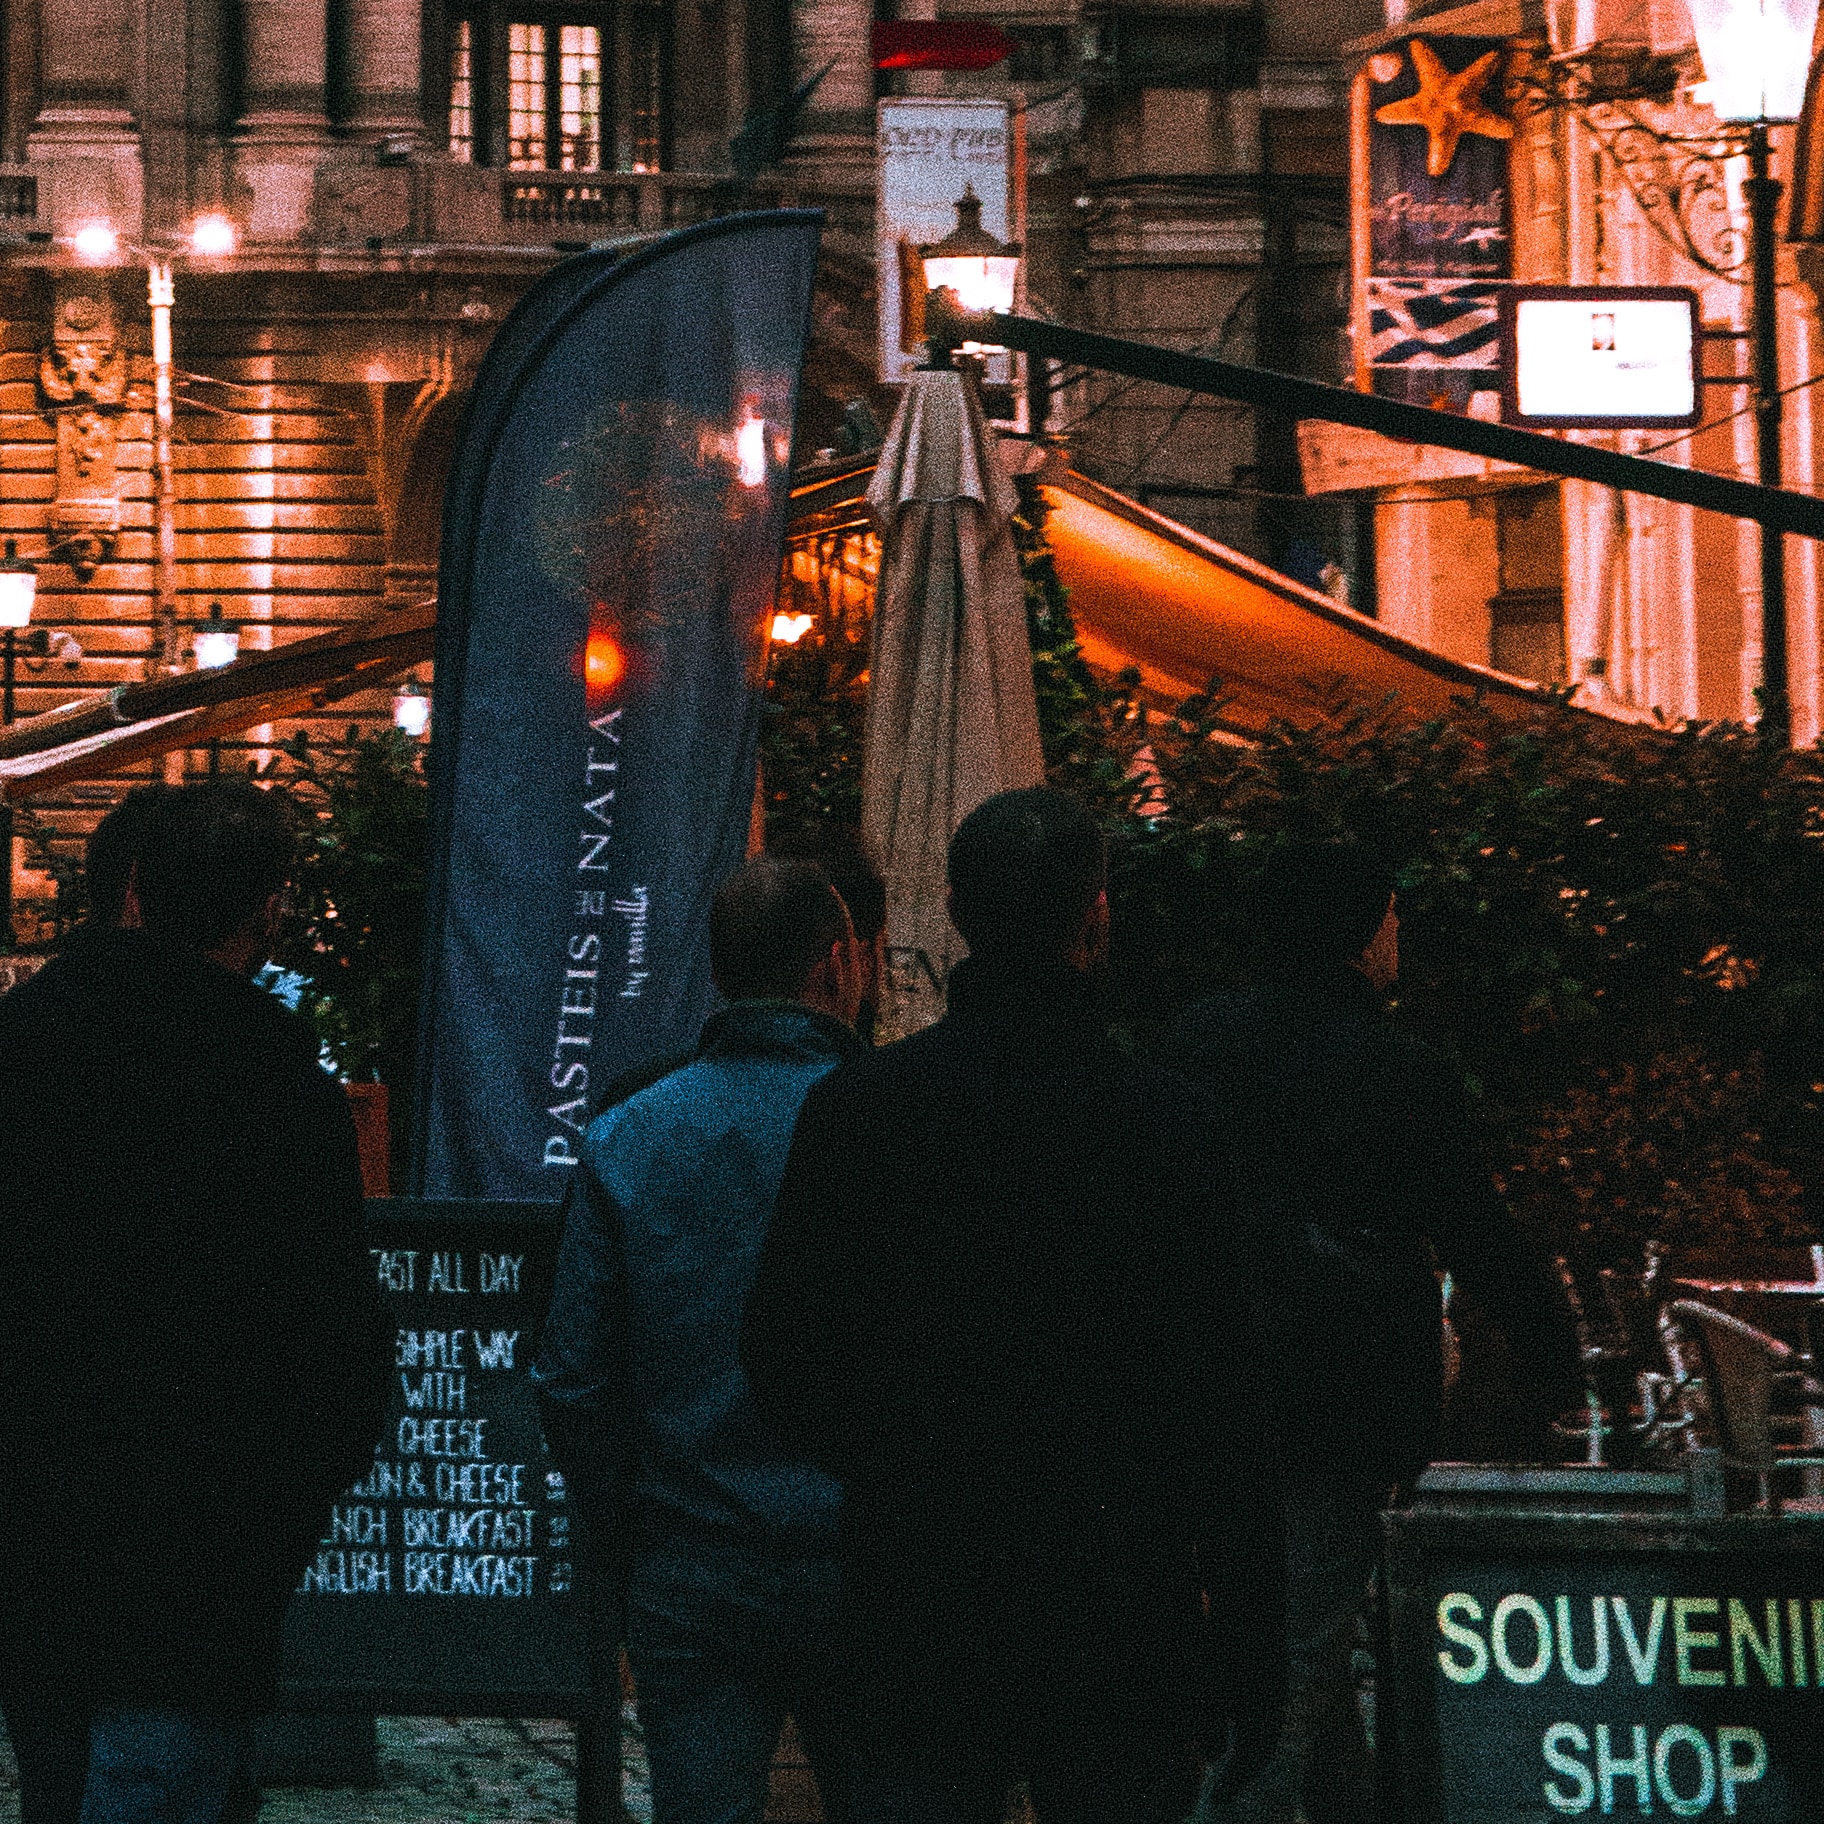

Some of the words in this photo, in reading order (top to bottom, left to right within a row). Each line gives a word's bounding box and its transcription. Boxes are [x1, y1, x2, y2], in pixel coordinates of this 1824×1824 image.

[542, 933, 602, 1166] PASTEIS
[577, 707, 624, 873] NATA
[428, 1251, 470, 1293] ALL
[480, 1252, 525, 1293] DAY
[473, 1328, 520, 1370] WAY
[400, 1370, 467, 1412] WITH
[397, 1415, 489, 1459] CHEESE
[434, 1462, 527, 1505] CHEESE
[402, 1507, 537, 1548] BREAKFAST
[403, 1551, 539, 1597] BREAKFAST
[1437, 1591, 1824, 1688] SOUVENI
[1542, 1721, 1769, 1817] SHOP
